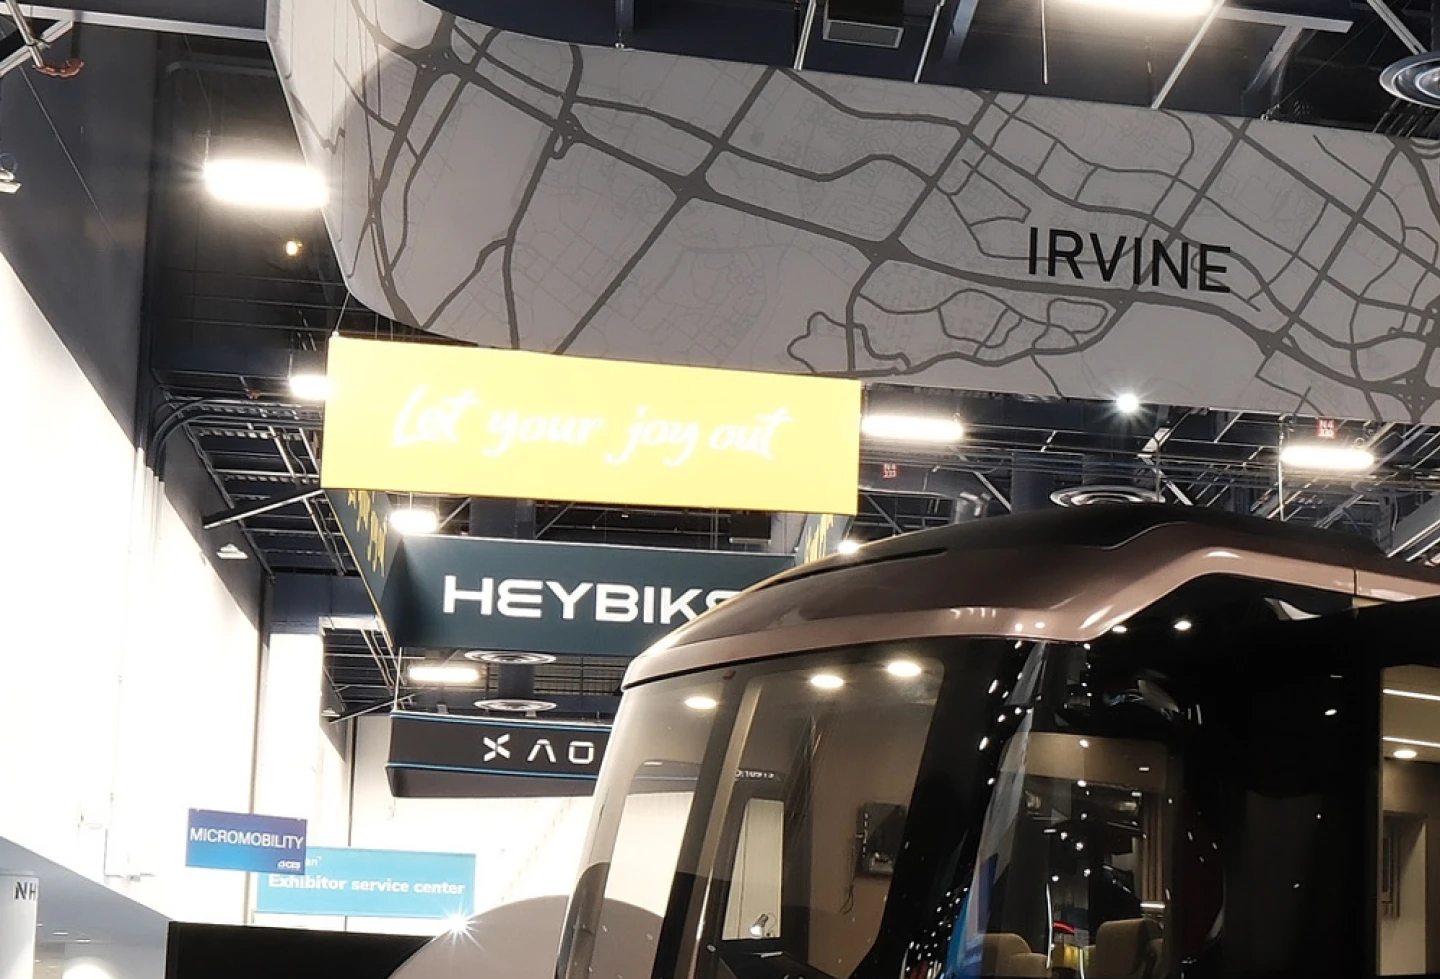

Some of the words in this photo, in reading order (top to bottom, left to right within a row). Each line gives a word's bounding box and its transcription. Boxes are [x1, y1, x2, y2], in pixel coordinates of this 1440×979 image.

[1028, 227, 1231, 293] IRVINE
[392, 384, 482, 447] Let
[482, 409, 605, 458] your
[604, 405, 698, 467] joy
[708, 406, 795, 459] out
[190, 827, 303, 849] MICROMOBILITY
[268, 875, 345, 890] Exhibitor
[351, 878, 409, 893] service
[413, 882, 466, 895] center
